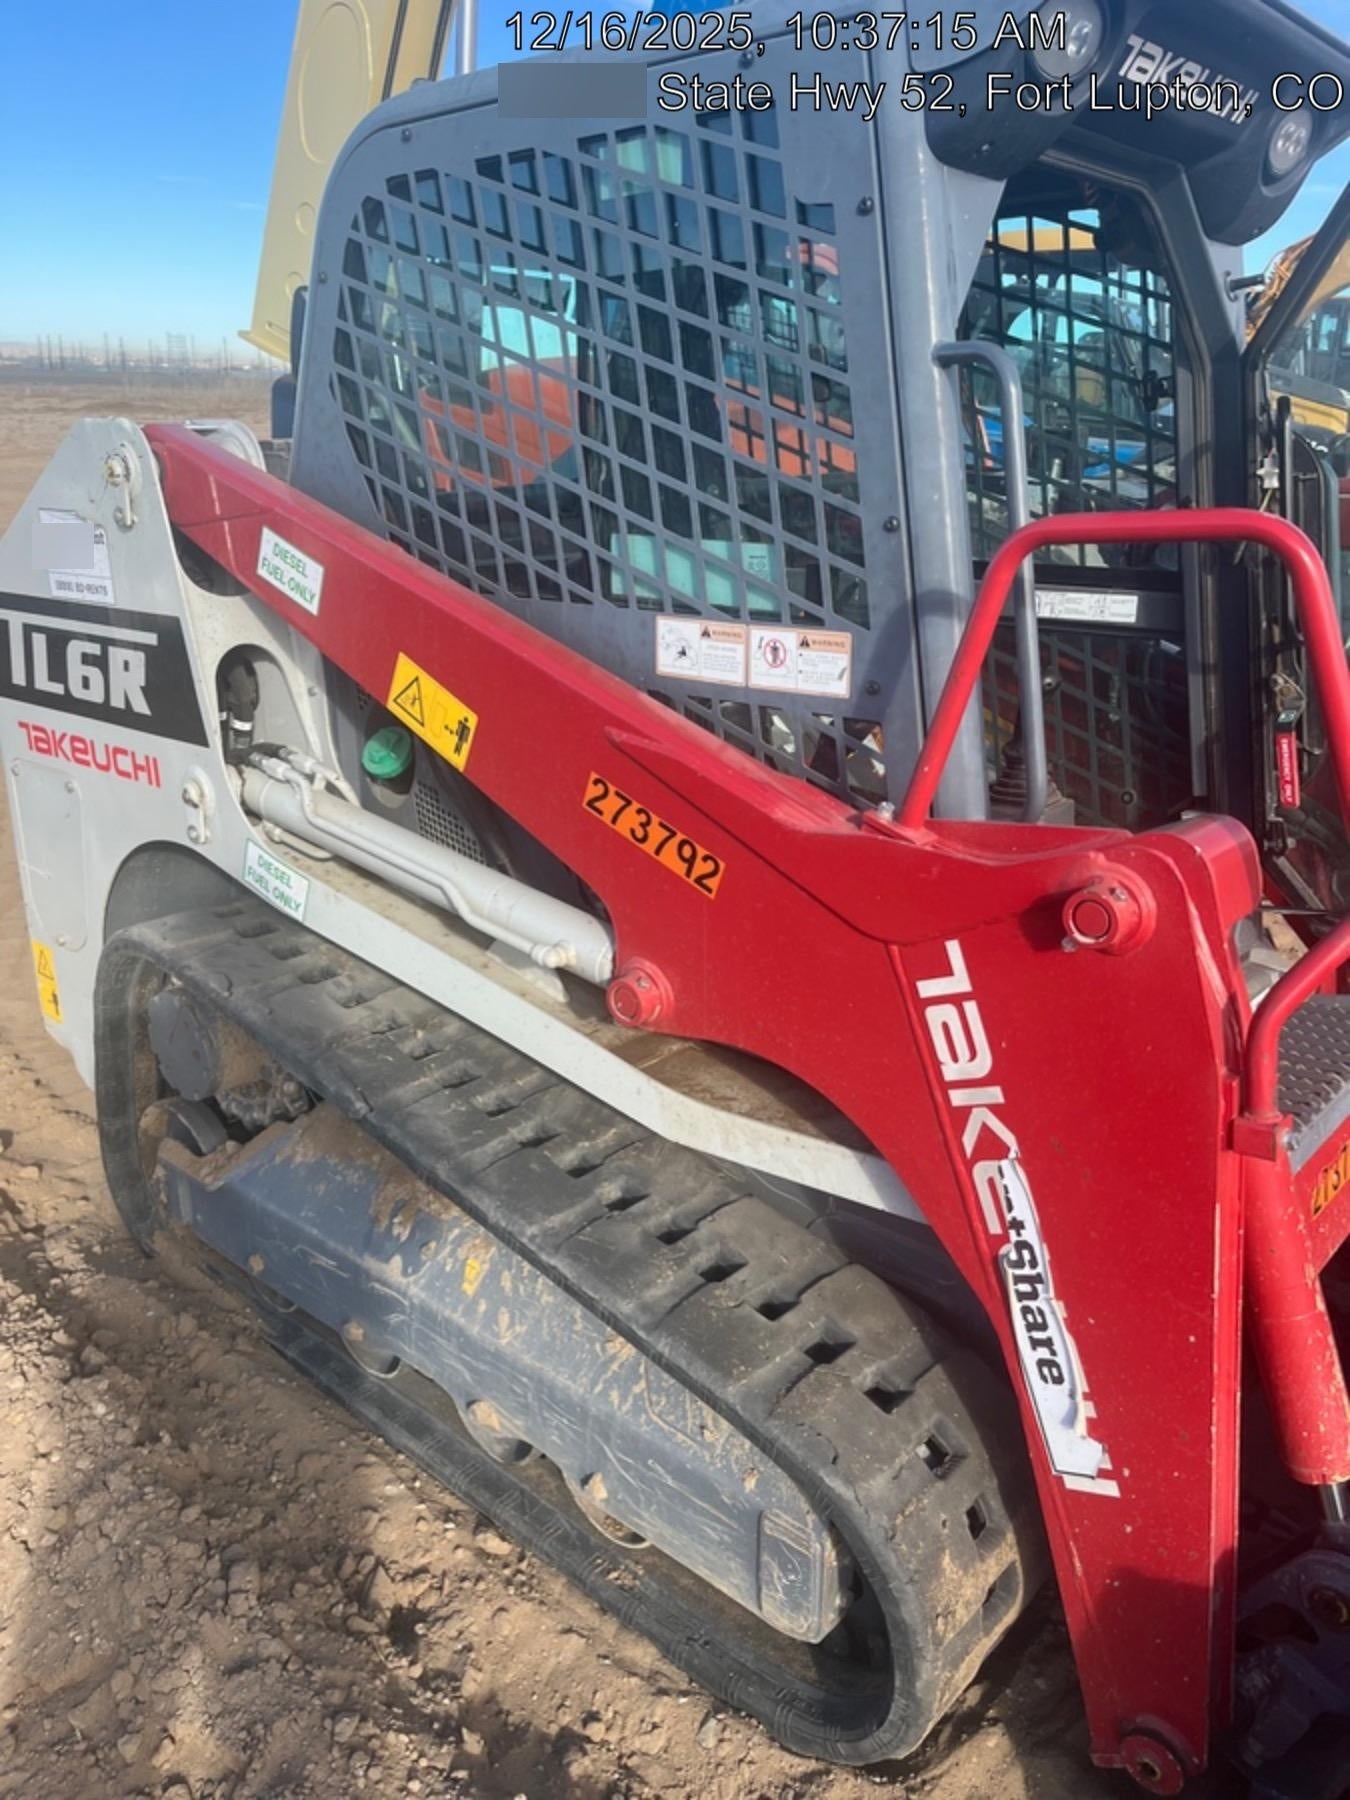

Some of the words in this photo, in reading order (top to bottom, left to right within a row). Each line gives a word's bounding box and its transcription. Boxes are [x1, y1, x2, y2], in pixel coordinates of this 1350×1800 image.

[261, 556, 286, 586] FUEL
[287, 576, 316, 605] ONLY
[272, 542, 308, 578] DIESEL
[0, 608, 158, 716] TL6R
[18, 720, 161, 788] TAKEUCHI
[586, 778, 720, 894] 273792
[258, 855, 292, 889] DIESEL
[271, 886, 302, 912] ONLY
